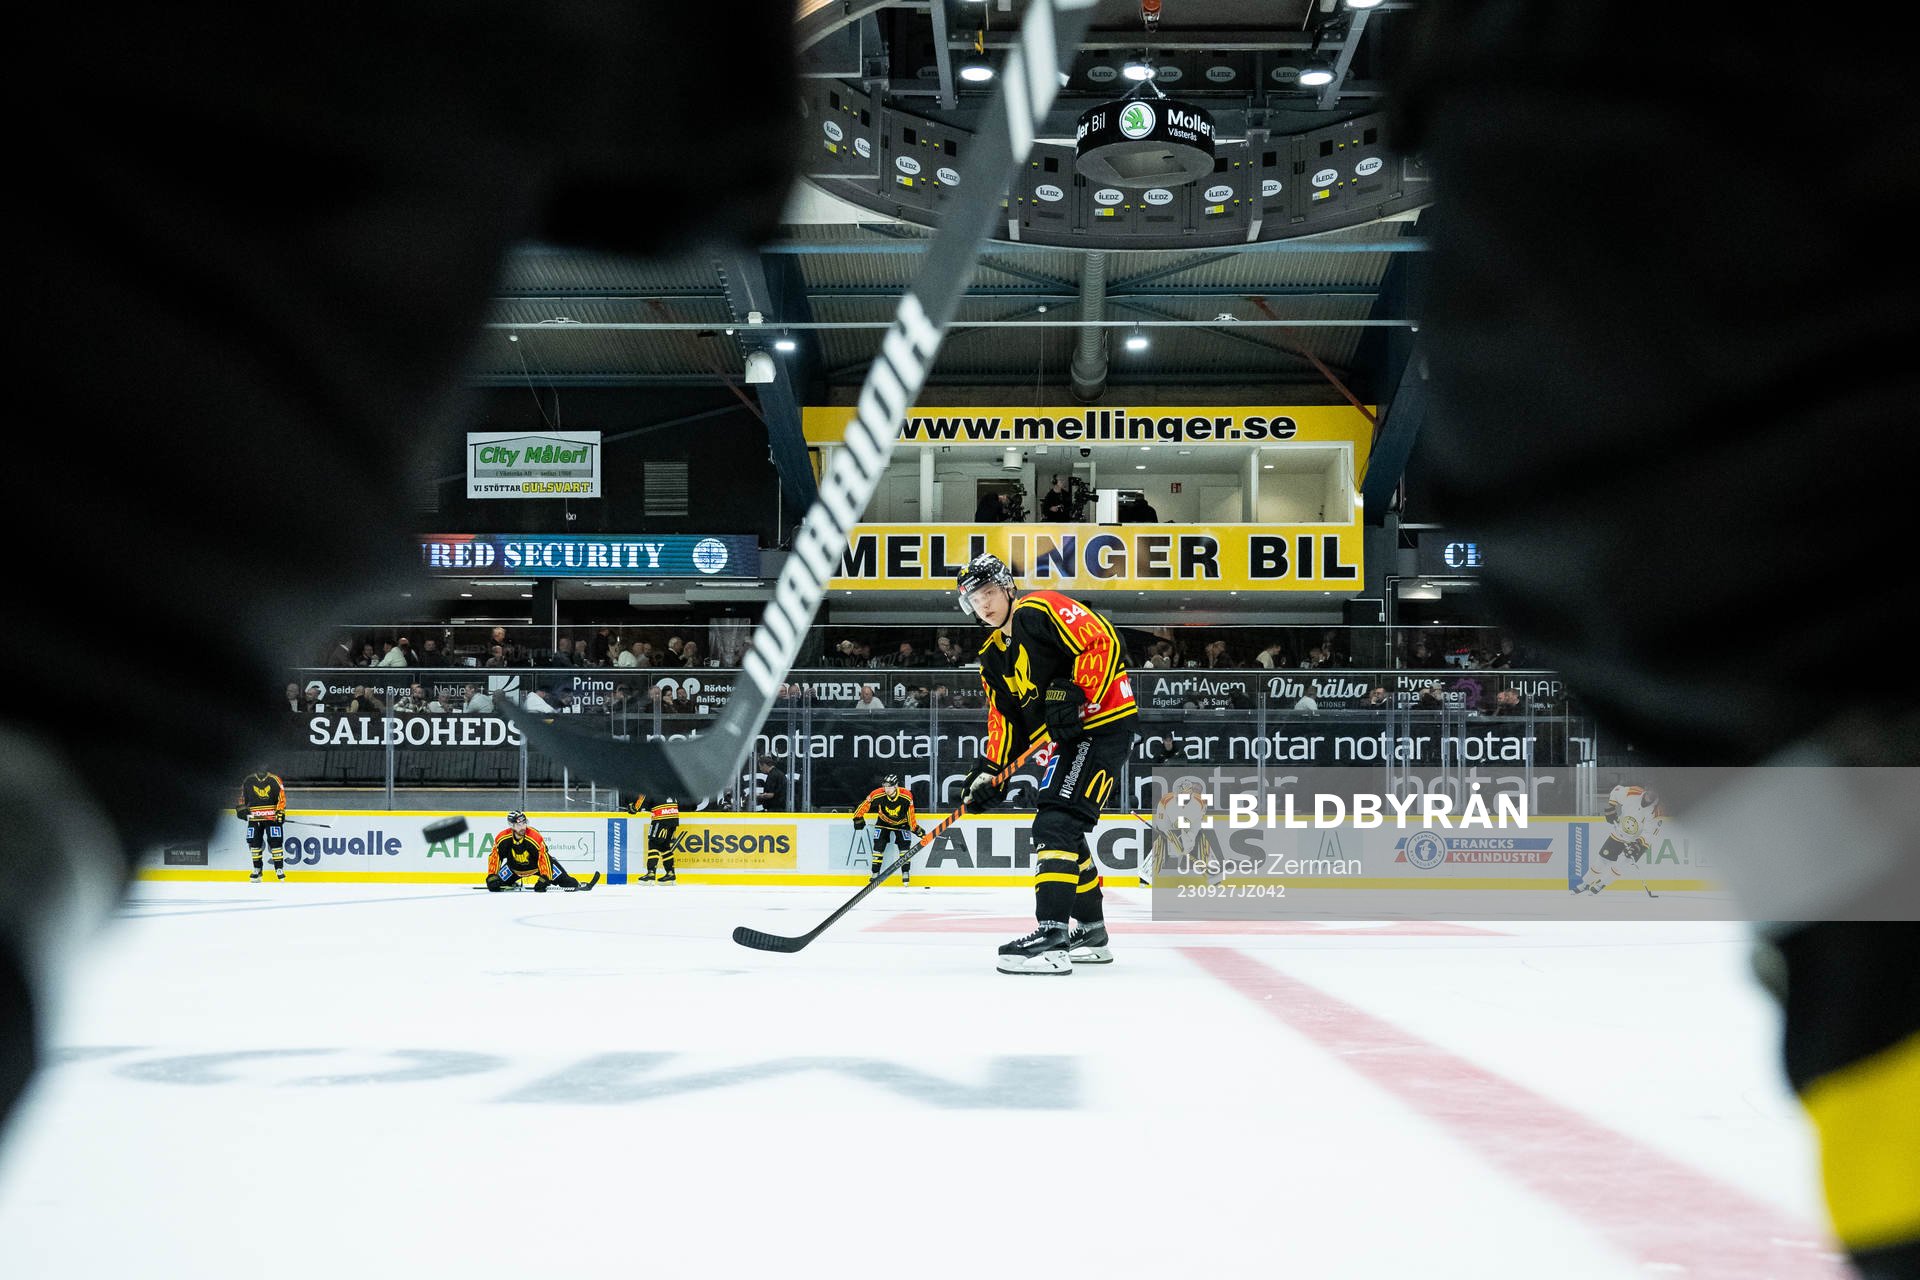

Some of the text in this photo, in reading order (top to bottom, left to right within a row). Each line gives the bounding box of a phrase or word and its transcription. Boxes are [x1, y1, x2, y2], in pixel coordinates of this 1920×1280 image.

[1092, 112, 1106, 132] Bil
[1167, 127, 1197, 142] Västerås
[896, 410, 1297, 442] www.mellinger.se
[480, 444, 588, 468] City Måleri
[473, 484, 483, 492] VI
[484, 483, 521, 492] STÖTTAR
[420, 543, 665, 568] RED SECURITY
[830, 535, 1357, 579] MELLINGER BIL
[1058, 603, 1087, 624] 34
[386, 685, 411, 696] Bygg
[573, 676, 614, 691] Prima
[1267, 676, 1305, 698] Din
[754, 729, 844, 759] notar
[853, 729, 948, 759] notar
[1229, 731, 1325, 760] notar
[1335, 731, 1431, 760] notar
[1441, 731, 1537, 760] notar
[266, 831, 402, 866] ggwalle
[613, 821, 621, 872] WARRIOR
[1452, 838, 1514, 849] FRANCKS
[1574, 826, 1583, 877] WARRIOR
[1452, 852, 1540, 863] KYLINDUSTRI
